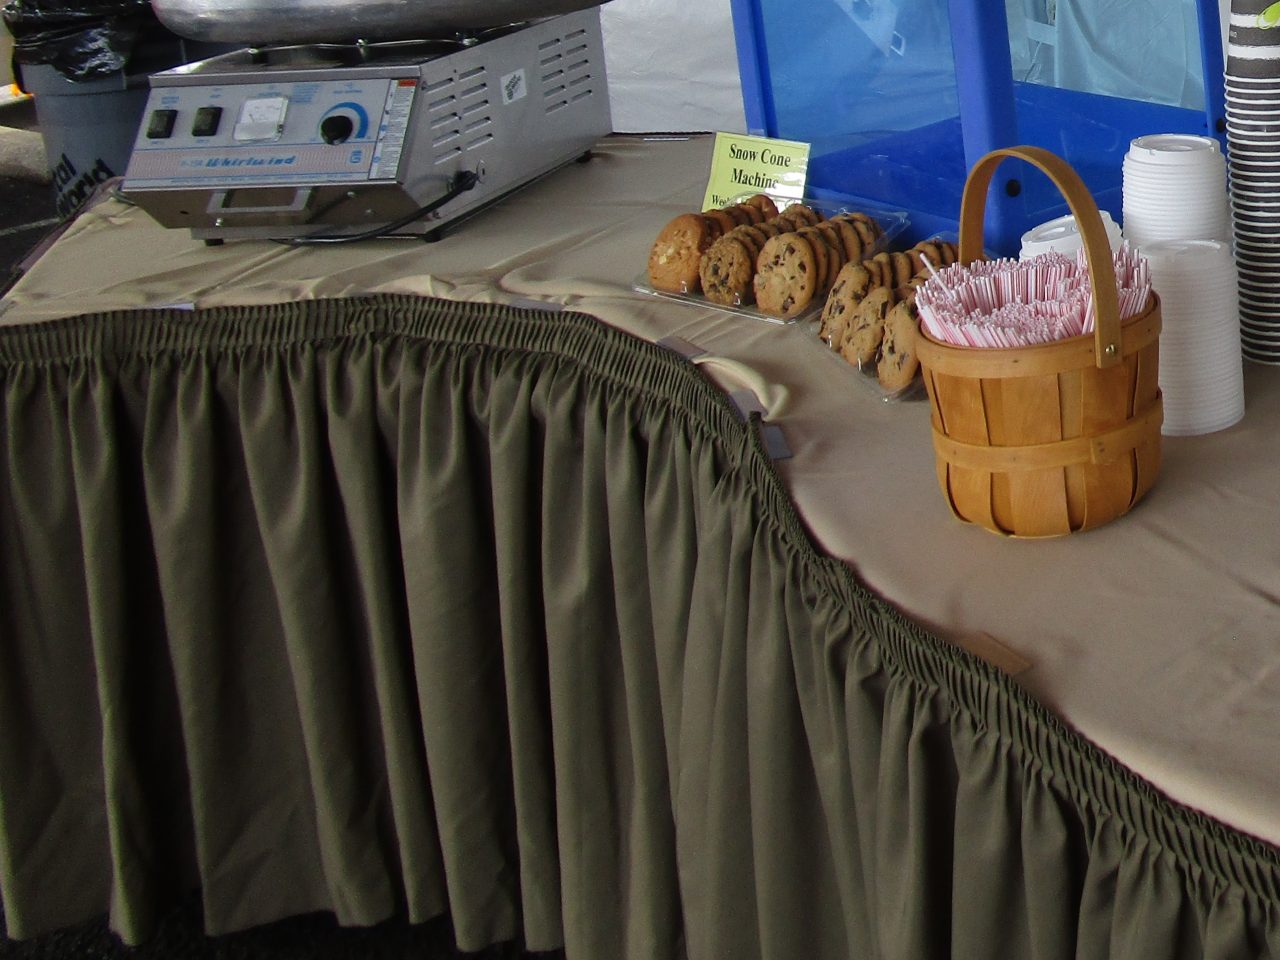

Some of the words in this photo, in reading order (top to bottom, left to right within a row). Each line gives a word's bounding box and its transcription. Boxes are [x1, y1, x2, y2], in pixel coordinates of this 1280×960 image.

[205, 154, 297, 168] Whirlwind
[729, 143, 758, 161] Snow
[761, 148, 791, 167] Cone
